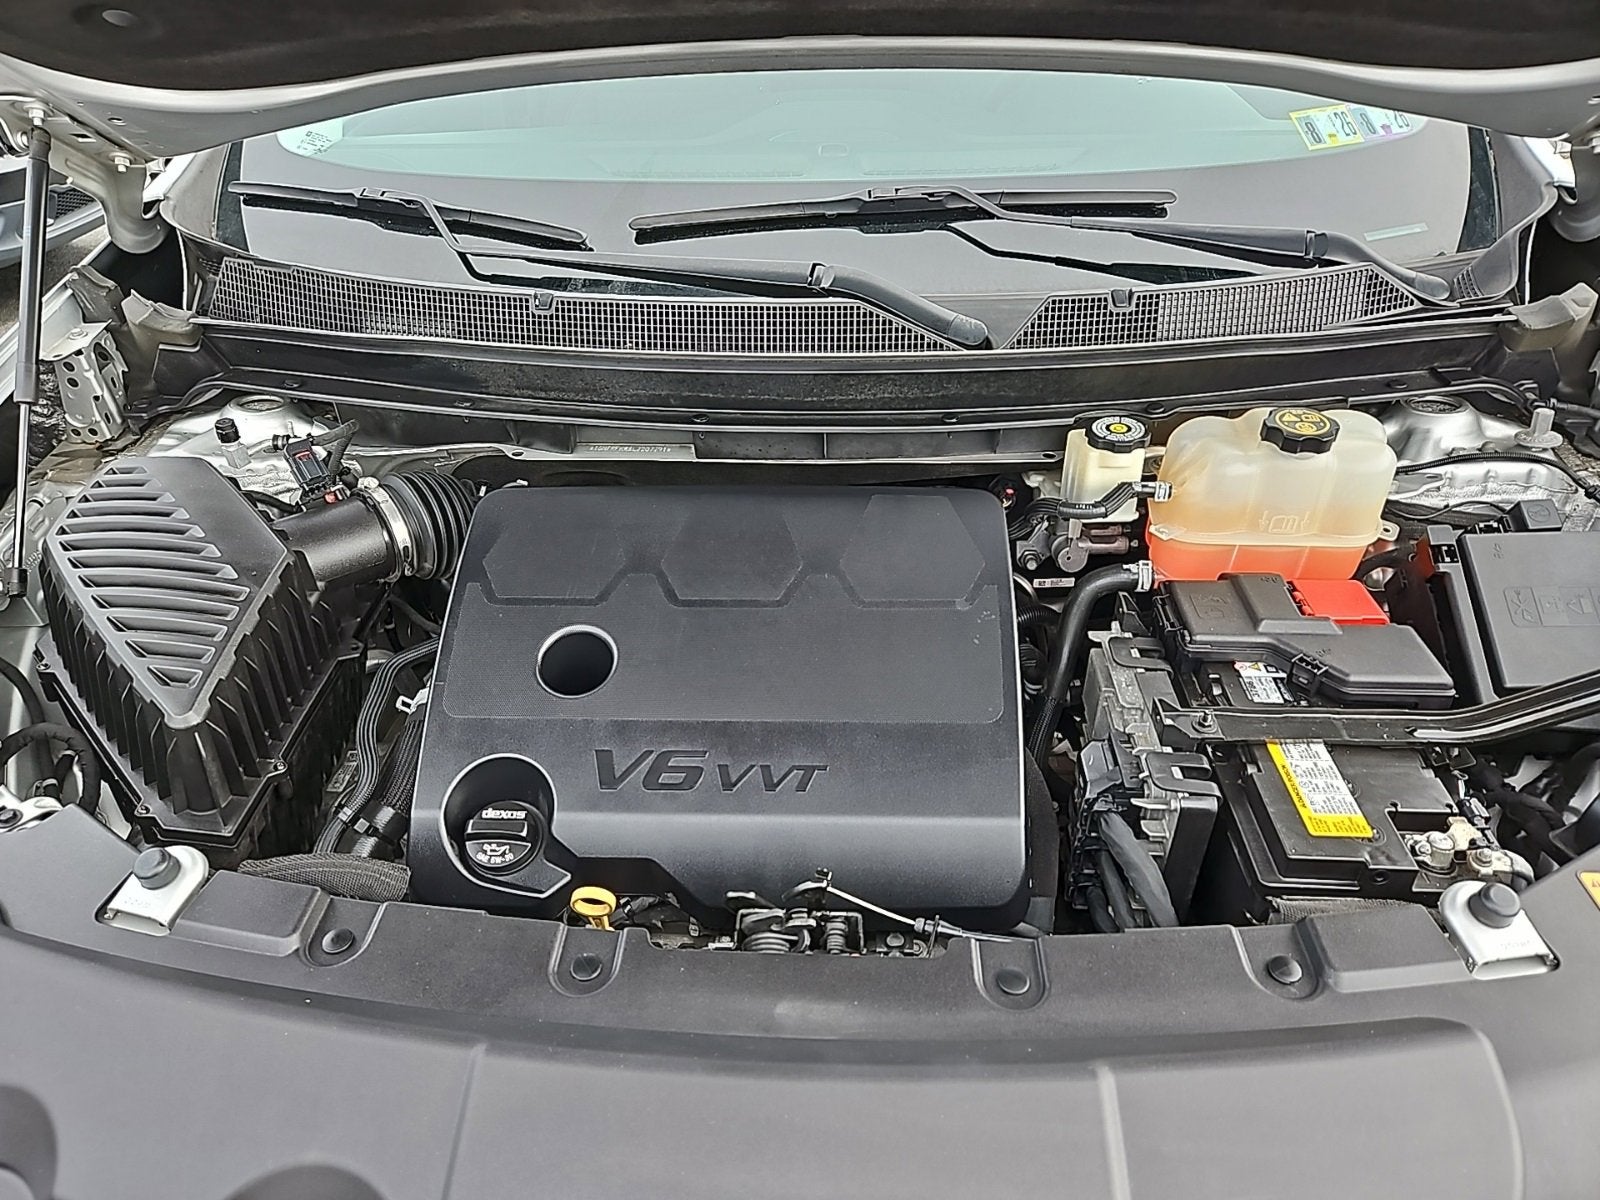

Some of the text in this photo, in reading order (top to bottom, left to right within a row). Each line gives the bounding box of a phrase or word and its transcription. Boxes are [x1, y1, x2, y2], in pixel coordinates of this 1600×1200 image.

[1334, 111, 1357, 137] 26
[594, 748, 830, 793] V6 VVT
[481, 807, 528, 819] dexos
